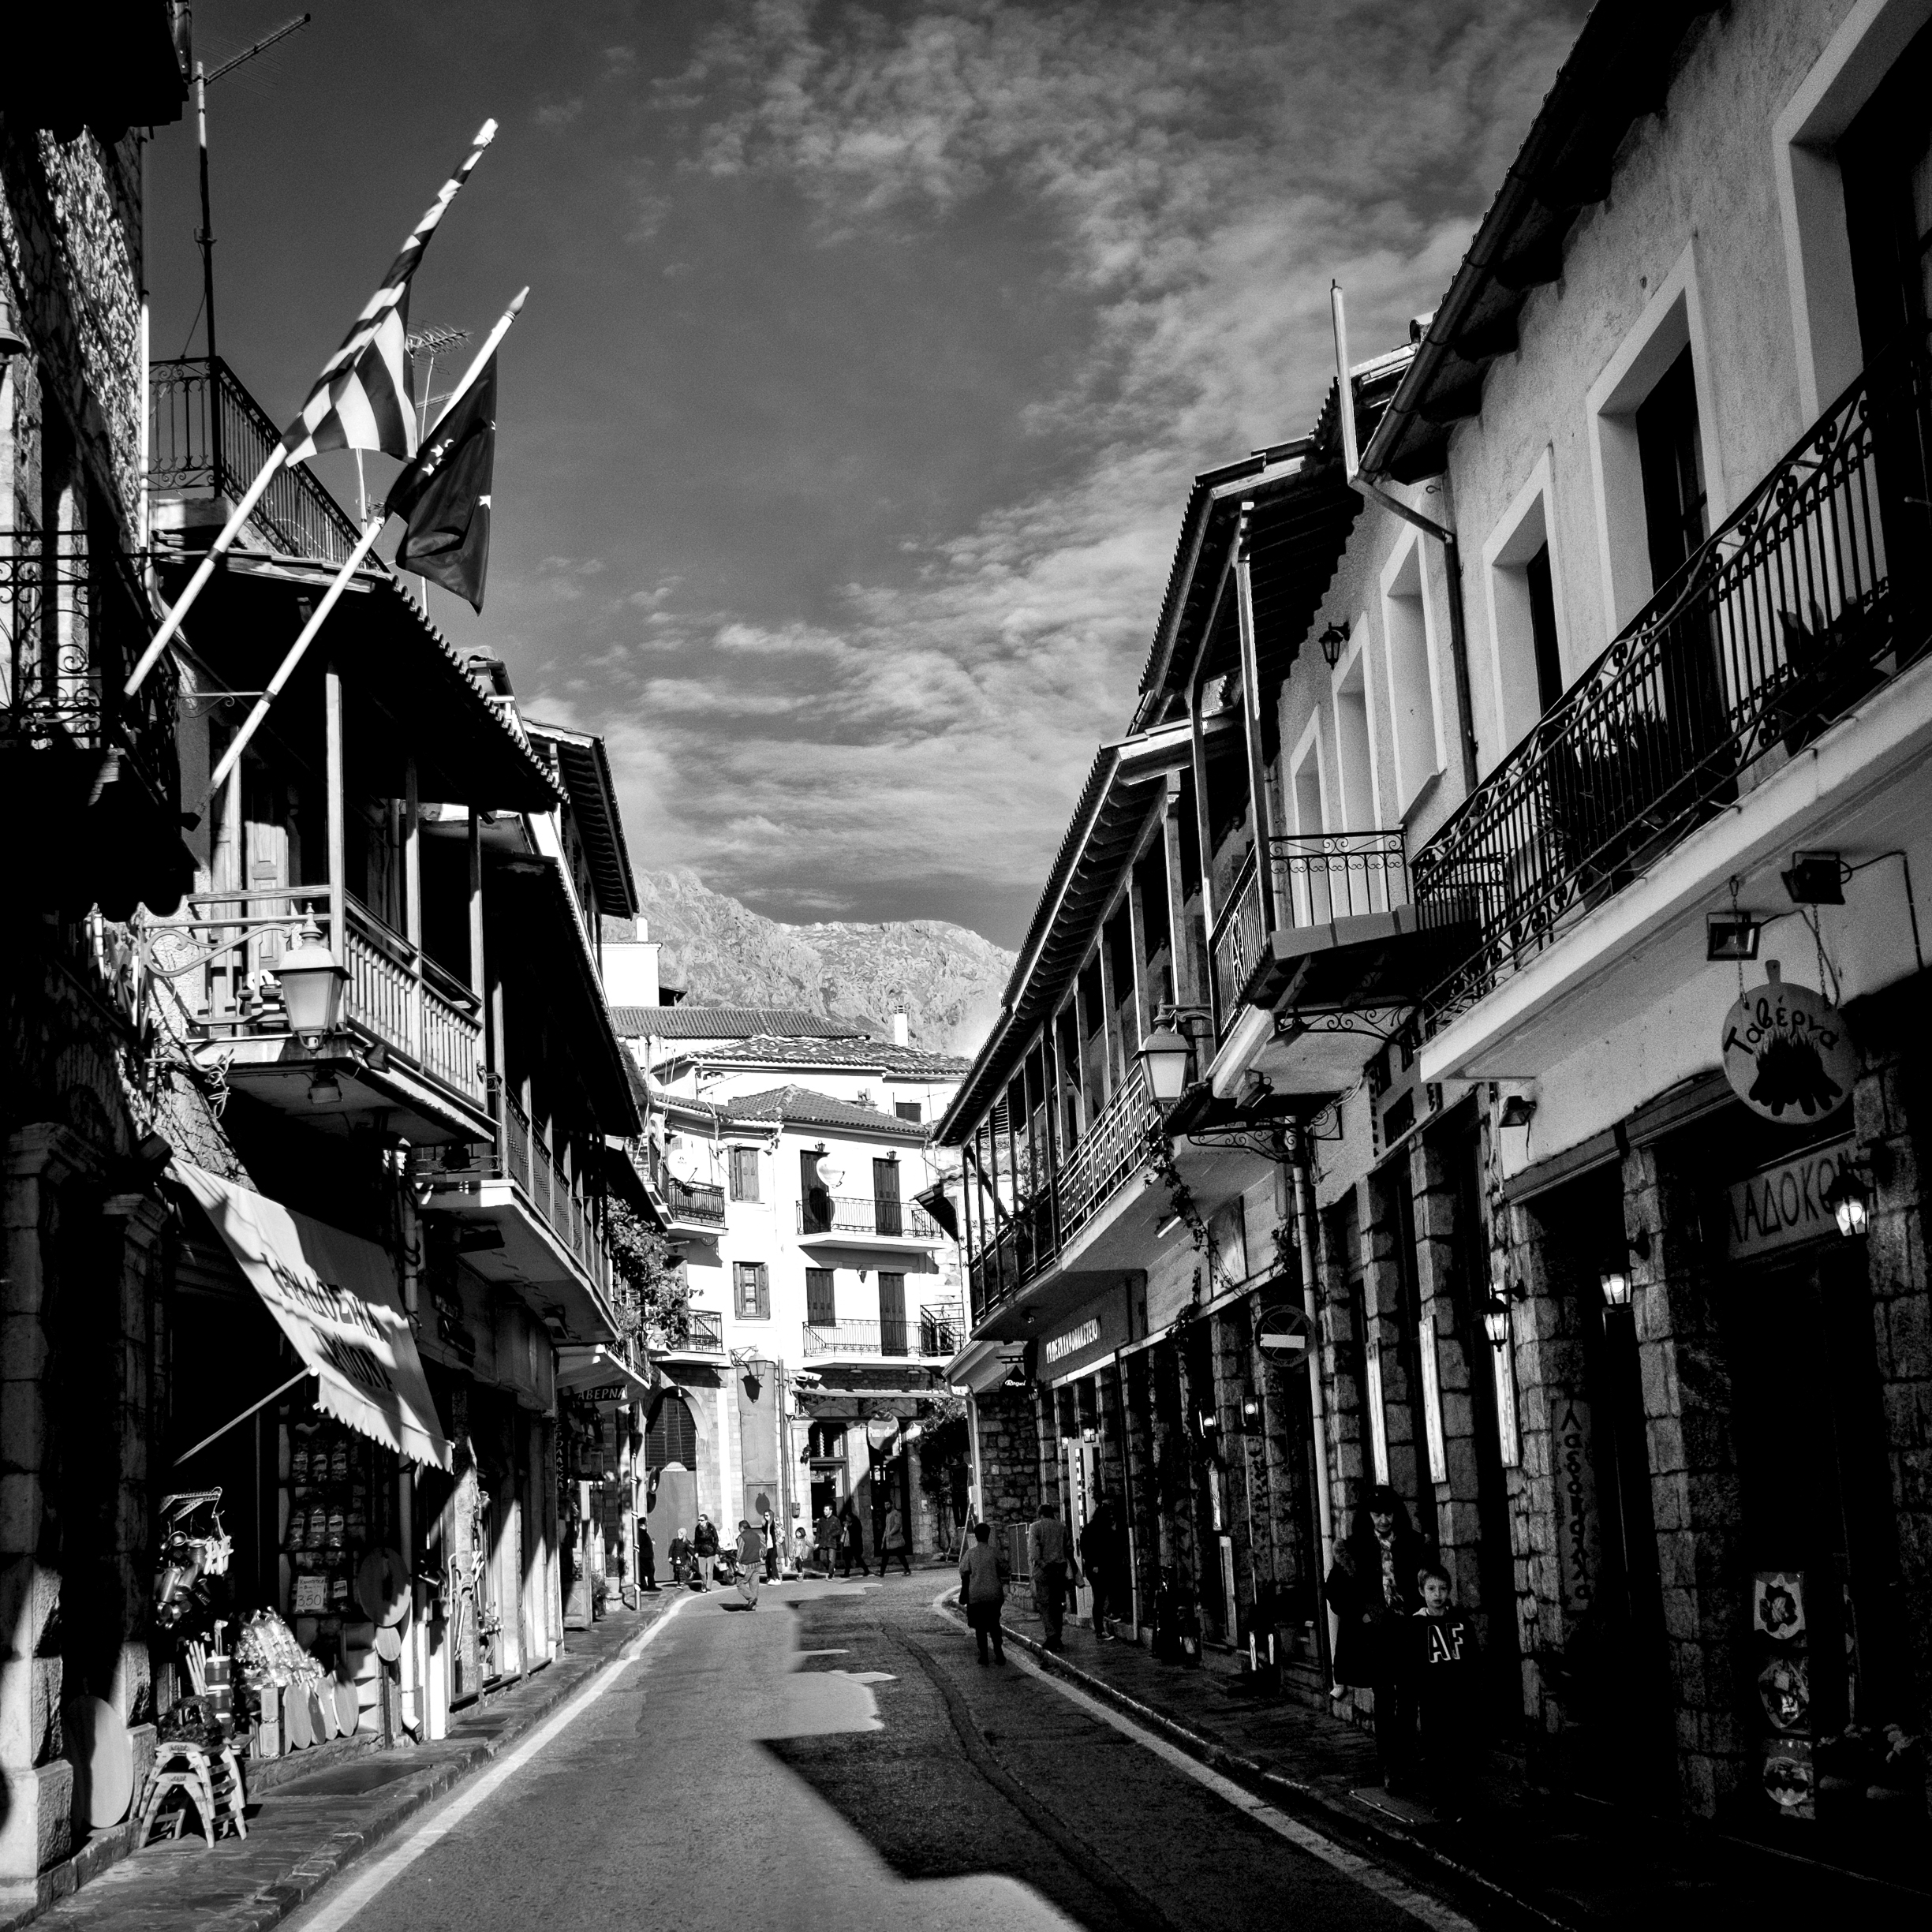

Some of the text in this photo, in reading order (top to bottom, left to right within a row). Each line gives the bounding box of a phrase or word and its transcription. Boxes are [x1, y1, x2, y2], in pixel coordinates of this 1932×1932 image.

[1723, 995, 1840, 1055] Ταβέρνα
[1727, 1150, 1849, 1243] ΑΔΟΚΟ
[577, 1387, 626, 1400] ΑΒΕΡΝΑ
[1427, 1622, 1465, 1664] AF
